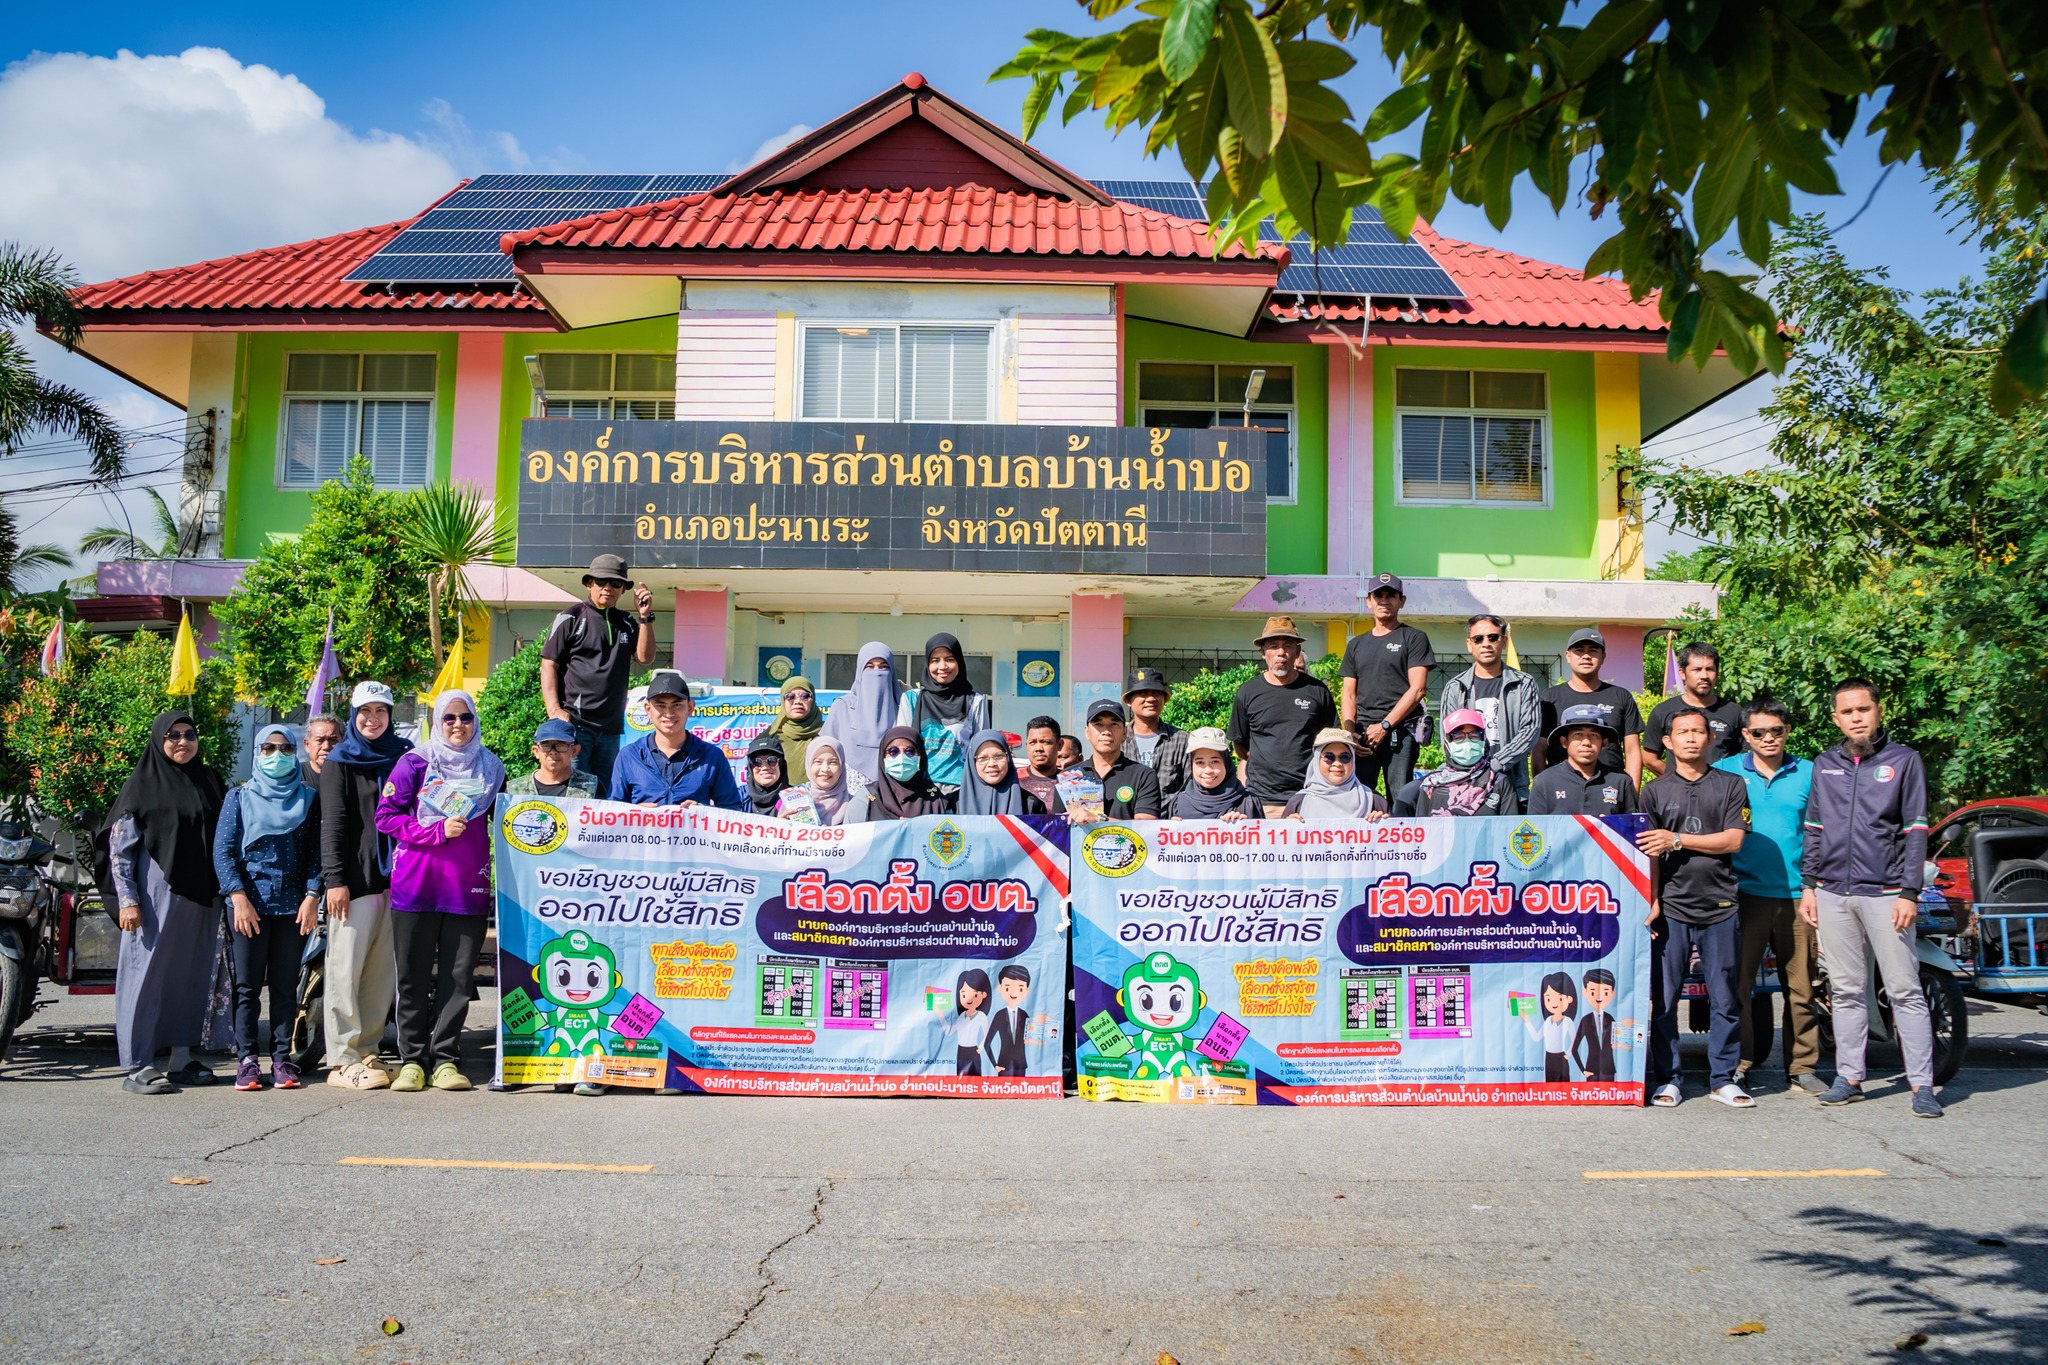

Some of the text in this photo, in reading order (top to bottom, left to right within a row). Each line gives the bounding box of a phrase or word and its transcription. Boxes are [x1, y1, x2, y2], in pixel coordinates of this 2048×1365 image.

[527, 427, 1251, 492] องค์การบริหารส่วนตำบลบ้านน้ำบ่อ
[635, 504, 1148, 547] อำเภอปะนาเระ จังหวัดปัตตานี
[578, 805, 846, 842] วันอาทิตย์ที่ 11 มกราคม 2569
[1157, 820, 1426, 847] วันอาทิตย์ที่ 11 มกราคม 2569
[577, 827, 628, 844] ตั้งแต่เวลา
[630, 834, 697, 846] 08.00-17.00
[1157, 847, 1427, 863] ตั้งแต่เวลา 08.00-17.00 น. ณ เขตเลือกตั้งที่ท่านมีรายชื่อ
[539, 867, 757, 898] ขอเชิญชวนผู้มีสิทธิ
[786, 863, 1035, 914] เลือกตั้ง อบต.
[1368, 865, 1615, 917] เลือกตั้ง อบต.
[538, 895, 745, 926] ออกไปใช้สิทธิ
[1119, 888, 1338, 916] ขอเชิญชวนผู้มีสิทธิ
[1119, 914, 1325, 943] ออกไปใช้สิทธิ
[1379, 920, 1577, 938] นายกองค์การบริหารส่วนตำบลบ้านน้ำบ่อ
[1356, 934, 1602, 954] และสมาชิกสภาองค์การบริหารส่วนตำบลบ้านน้ำบ่อ
[564, 1019, 590, 1029] ECT
[1100, 1034, 1124, 1052] อบต.
[1150, 1042, 1175, 1051] ECT
[1205, 1038, 1230, 1060] อบต.
[703, 1075, 897, 1094] องค์การบริหารส่วนตำบลบ้านน้ำบ่อ
[900, 1078, 979, 1094] อำเภอปะนาเระ
[1295, 1084, 1489, 1105] องค์การบริหารส่วนตำบลบ้านน้ำบ่อ
[1491, 1087, 1568, 1103] อำเภอปะนาเระ
